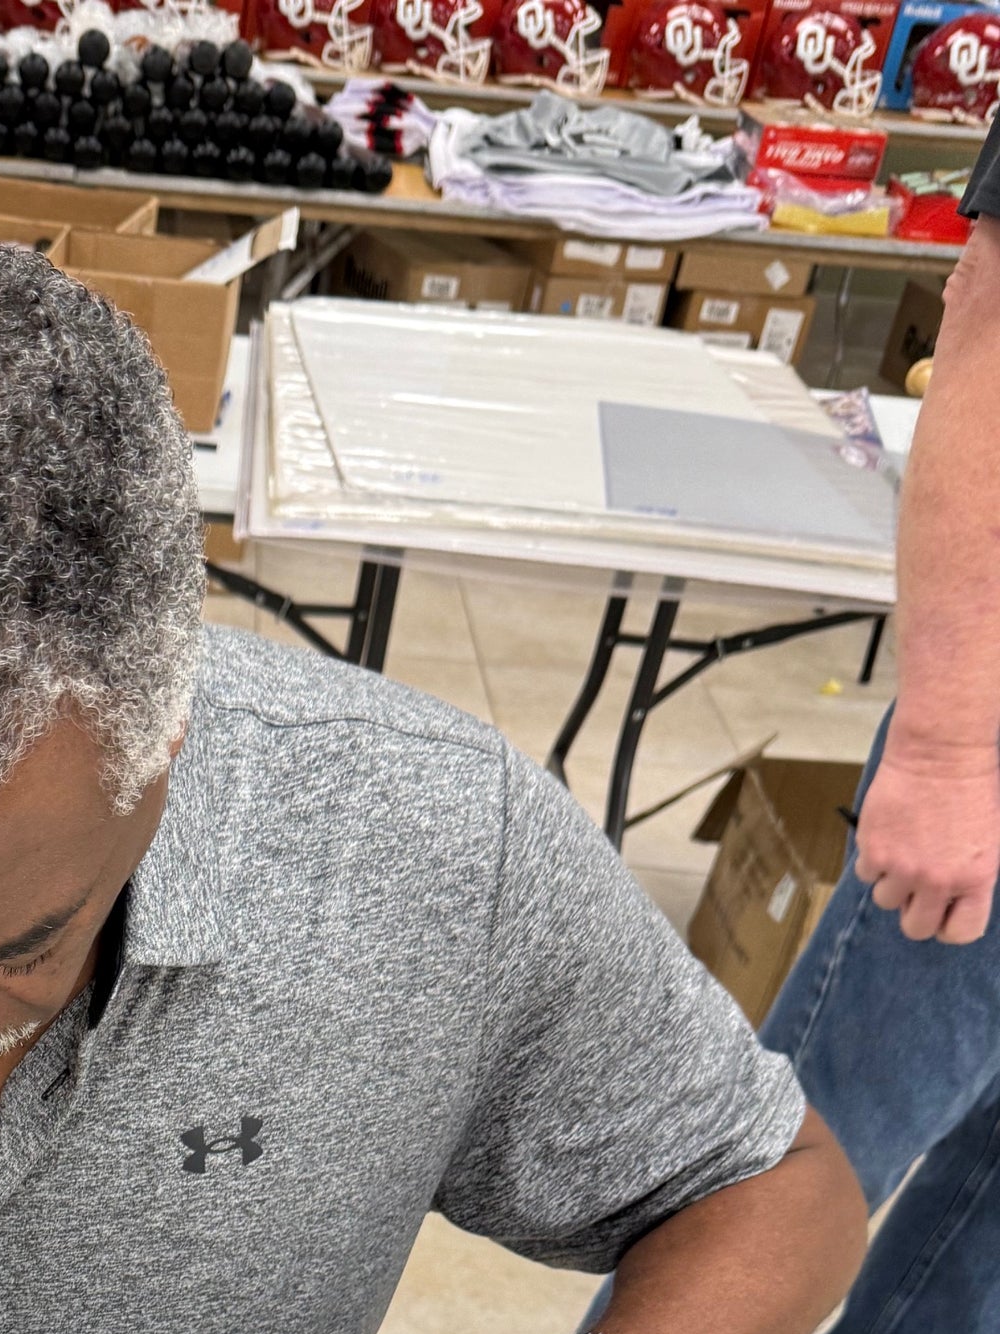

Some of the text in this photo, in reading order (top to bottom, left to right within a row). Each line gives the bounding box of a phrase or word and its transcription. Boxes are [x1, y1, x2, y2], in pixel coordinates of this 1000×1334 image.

[517, 0, 554, 49] OU
[665, 15, 704, 67] OU
[796, 22, 836, 75] OU
[949, 33, 988, 86] OU
